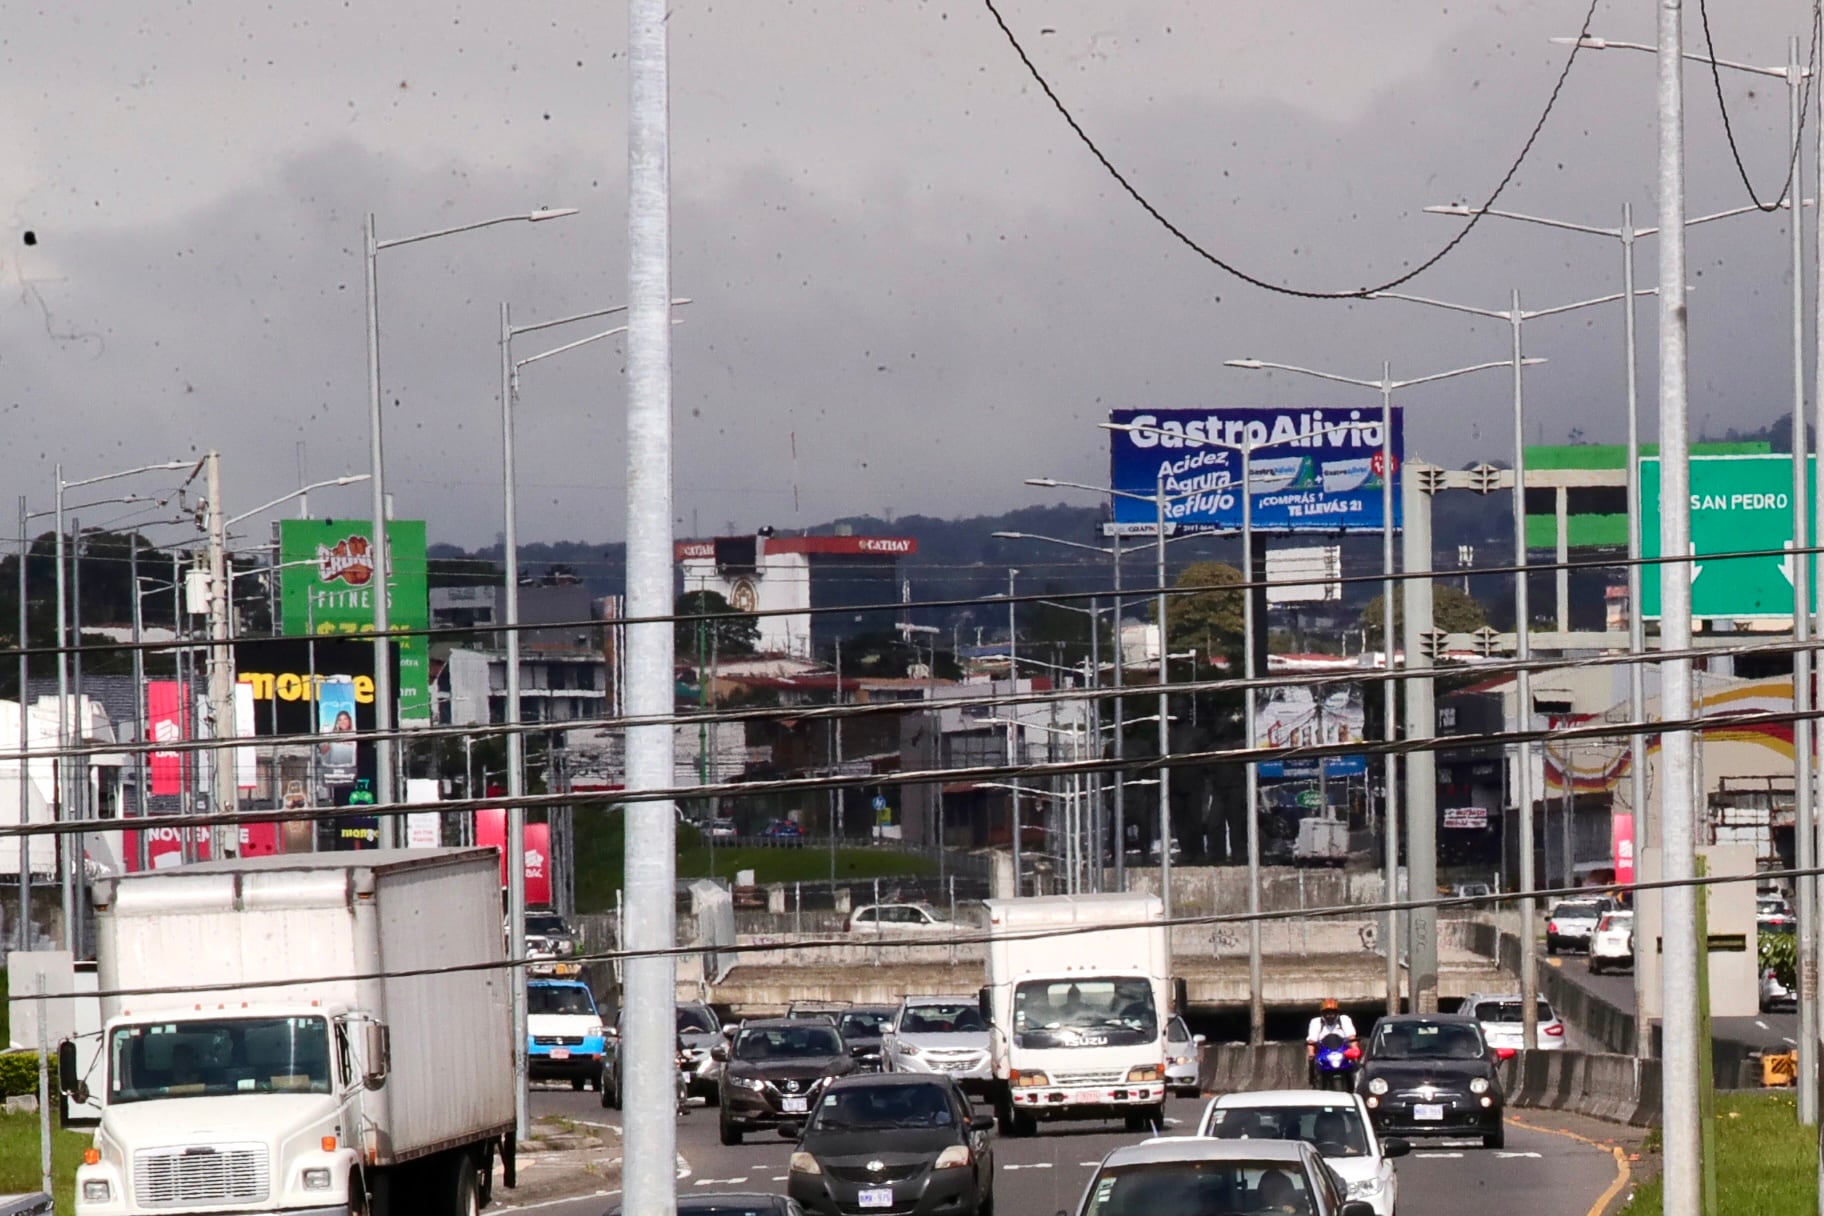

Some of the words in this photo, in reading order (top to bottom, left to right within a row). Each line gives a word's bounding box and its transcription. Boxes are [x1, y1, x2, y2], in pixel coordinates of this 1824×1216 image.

[1129, 410, 1385, 449] GastroAlivio
[1157, 451, 1229, 478] Acidez,
[1164, 470, 1232, 494] Agrura,
[1159, 493, 1235, 519] Reflujo
[1690, 494, 1727, 510] SAN
[1731, 493, 1788, 510] PEDRO
[318, 590, 392, 609] FITNES
[237, 671, 374, 704] mone
[1064, 1036, 1108, 1047] ISUZU
